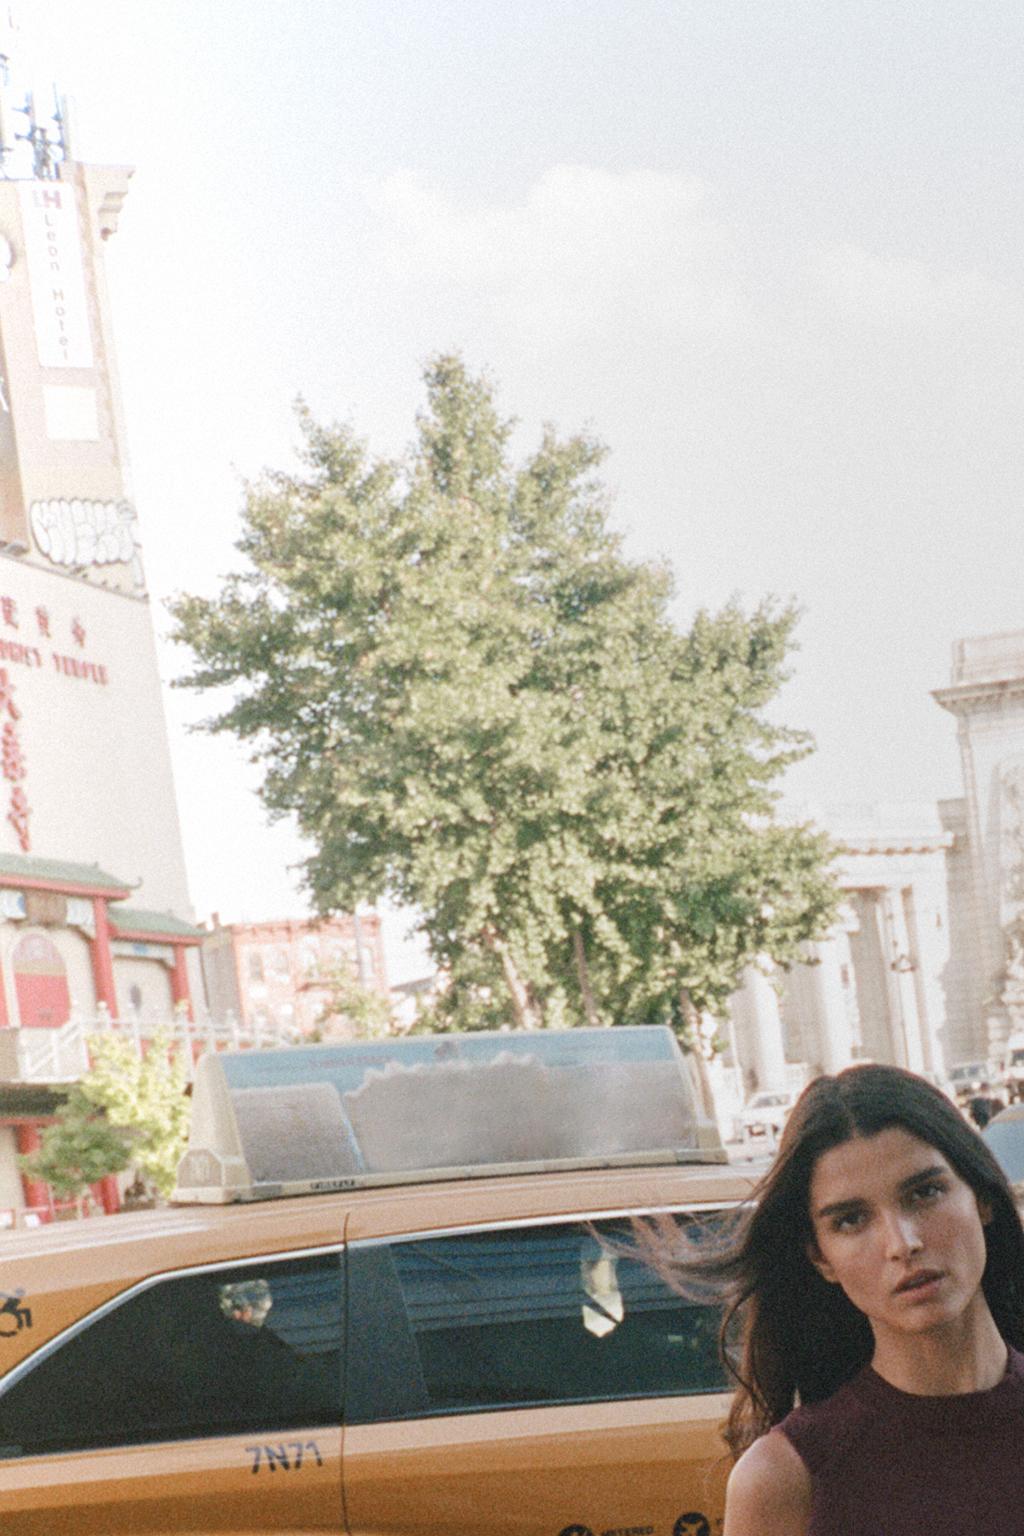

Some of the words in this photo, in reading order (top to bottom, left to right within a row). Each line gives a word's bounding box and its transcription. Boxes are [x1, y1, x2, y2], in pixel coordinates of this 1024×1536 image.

[44, 213, 60, 271] Leon
[53, 290, 69, 360] Hotel
[245, 1440, 323, 1473] 7N71
